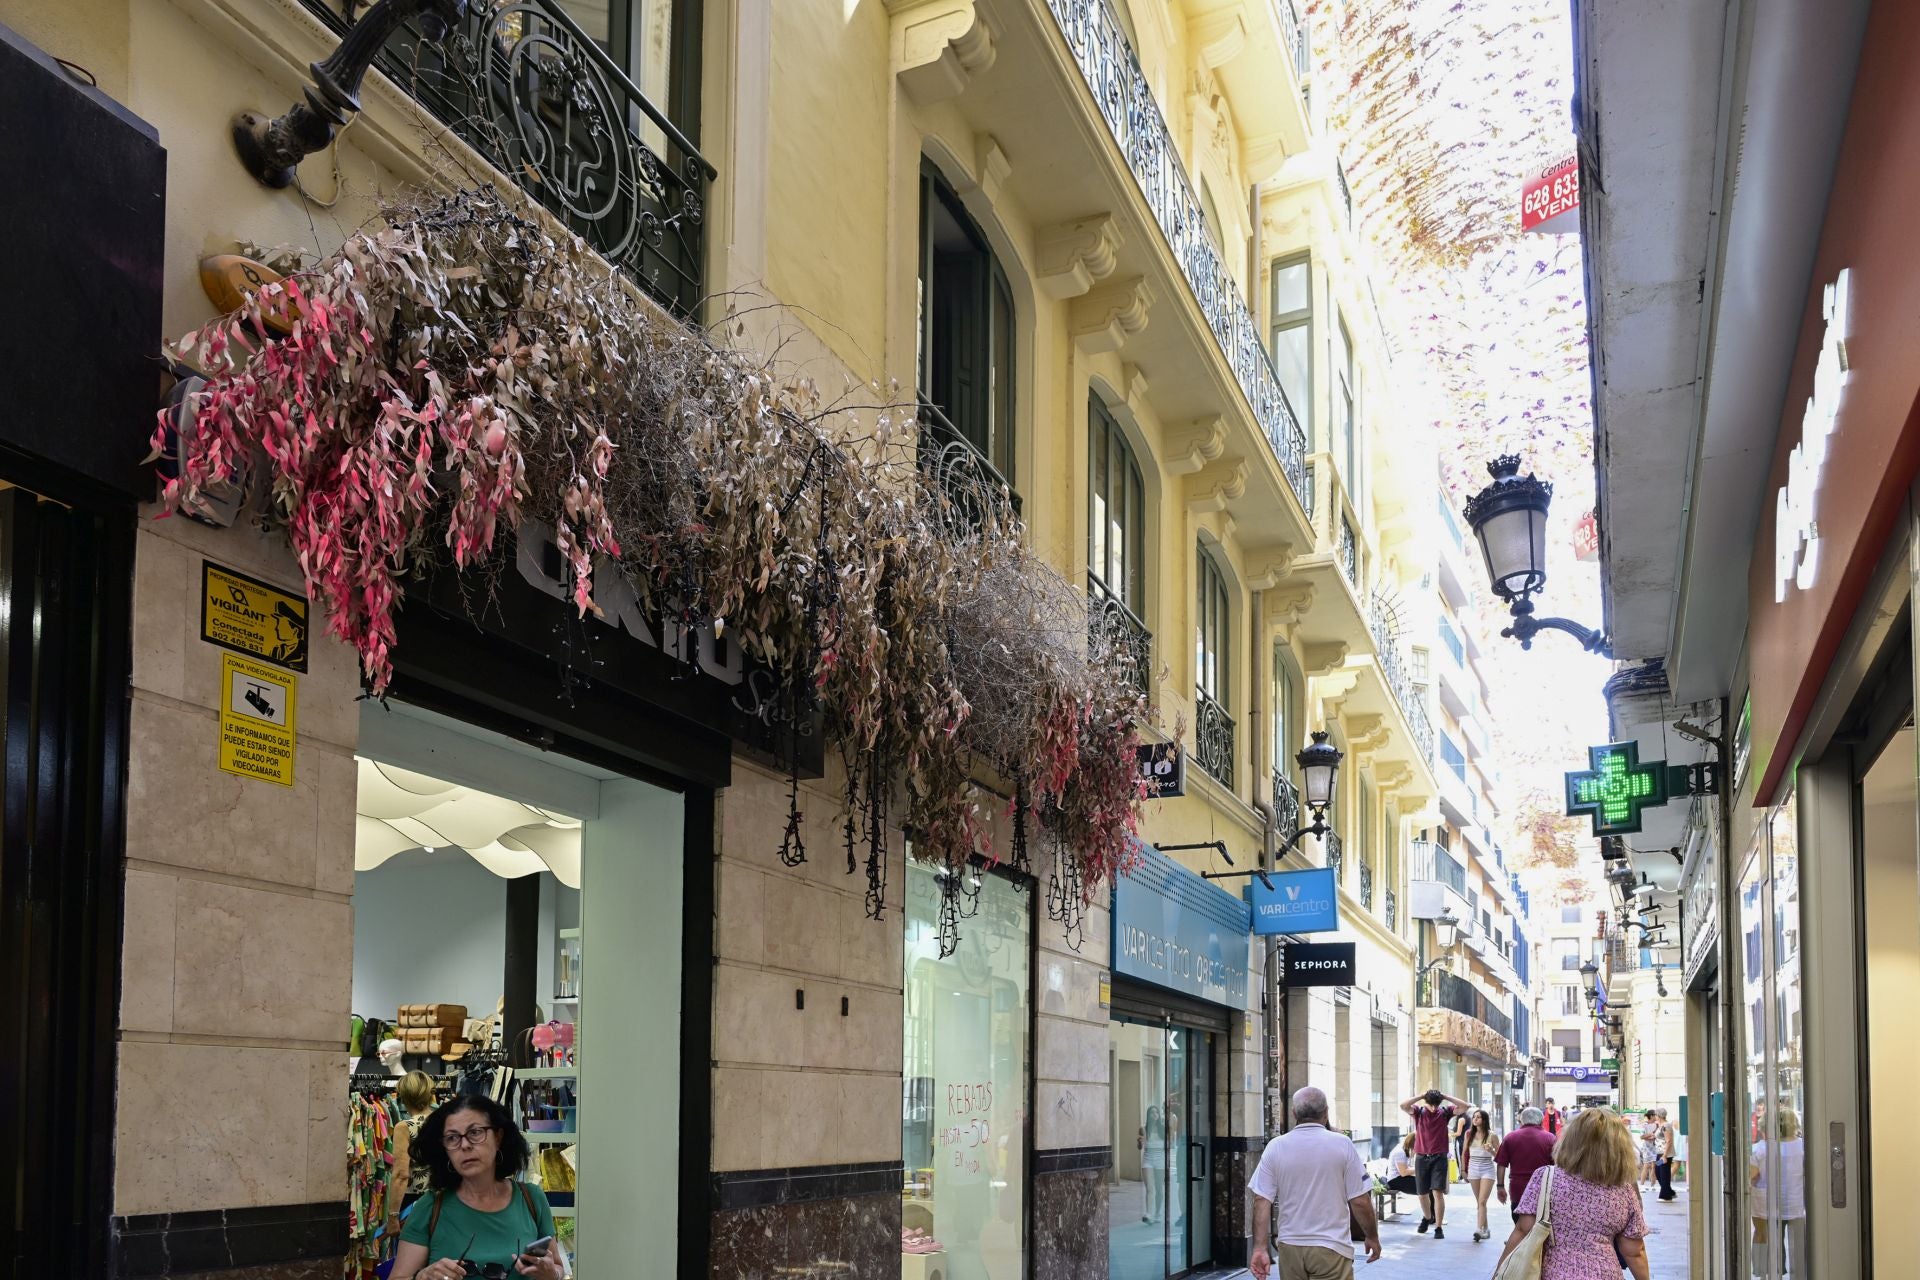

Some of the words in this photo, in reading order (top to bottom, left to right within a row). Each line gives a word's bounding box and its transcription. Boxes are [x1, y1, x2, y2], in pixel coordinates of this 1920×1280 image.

[1541, 156, 1575, 179] Centro
[1524, 184, 1550, 215] 628
[1553, 169, 1579, 198] 633
[209, 595, 268, 622] VIGILANT
[212, 618, 265, 641] Conectada
[212, 631, 228, 642] 902
[227, 659, 245, 669] ZONA
[246, 664, 292, 684] VIDEOVIGILADA
[224, 733, 246, 747] PUEDE
[246, 738, 267, 753] ESTAR
[268, 744, 291, 759] SIENDO
[225, 722, 234, 732] LE
[234, 723, 277, 743] INFORMAMOS
[277, 736, 290, 747] QUE
[235, 748, 265, 763] VIGILADO
[266, 755, 279, 767] POR
[1259, 898, 1329, 916] VARIcentro
[1122, 922, 1191, 979] VARIcentro
[1294, 960, 1348, 970] SEPHORA
[1545, 1067, 1572, 1075] AMILY
[948, 1081, 993, 1117] REBAJAS
